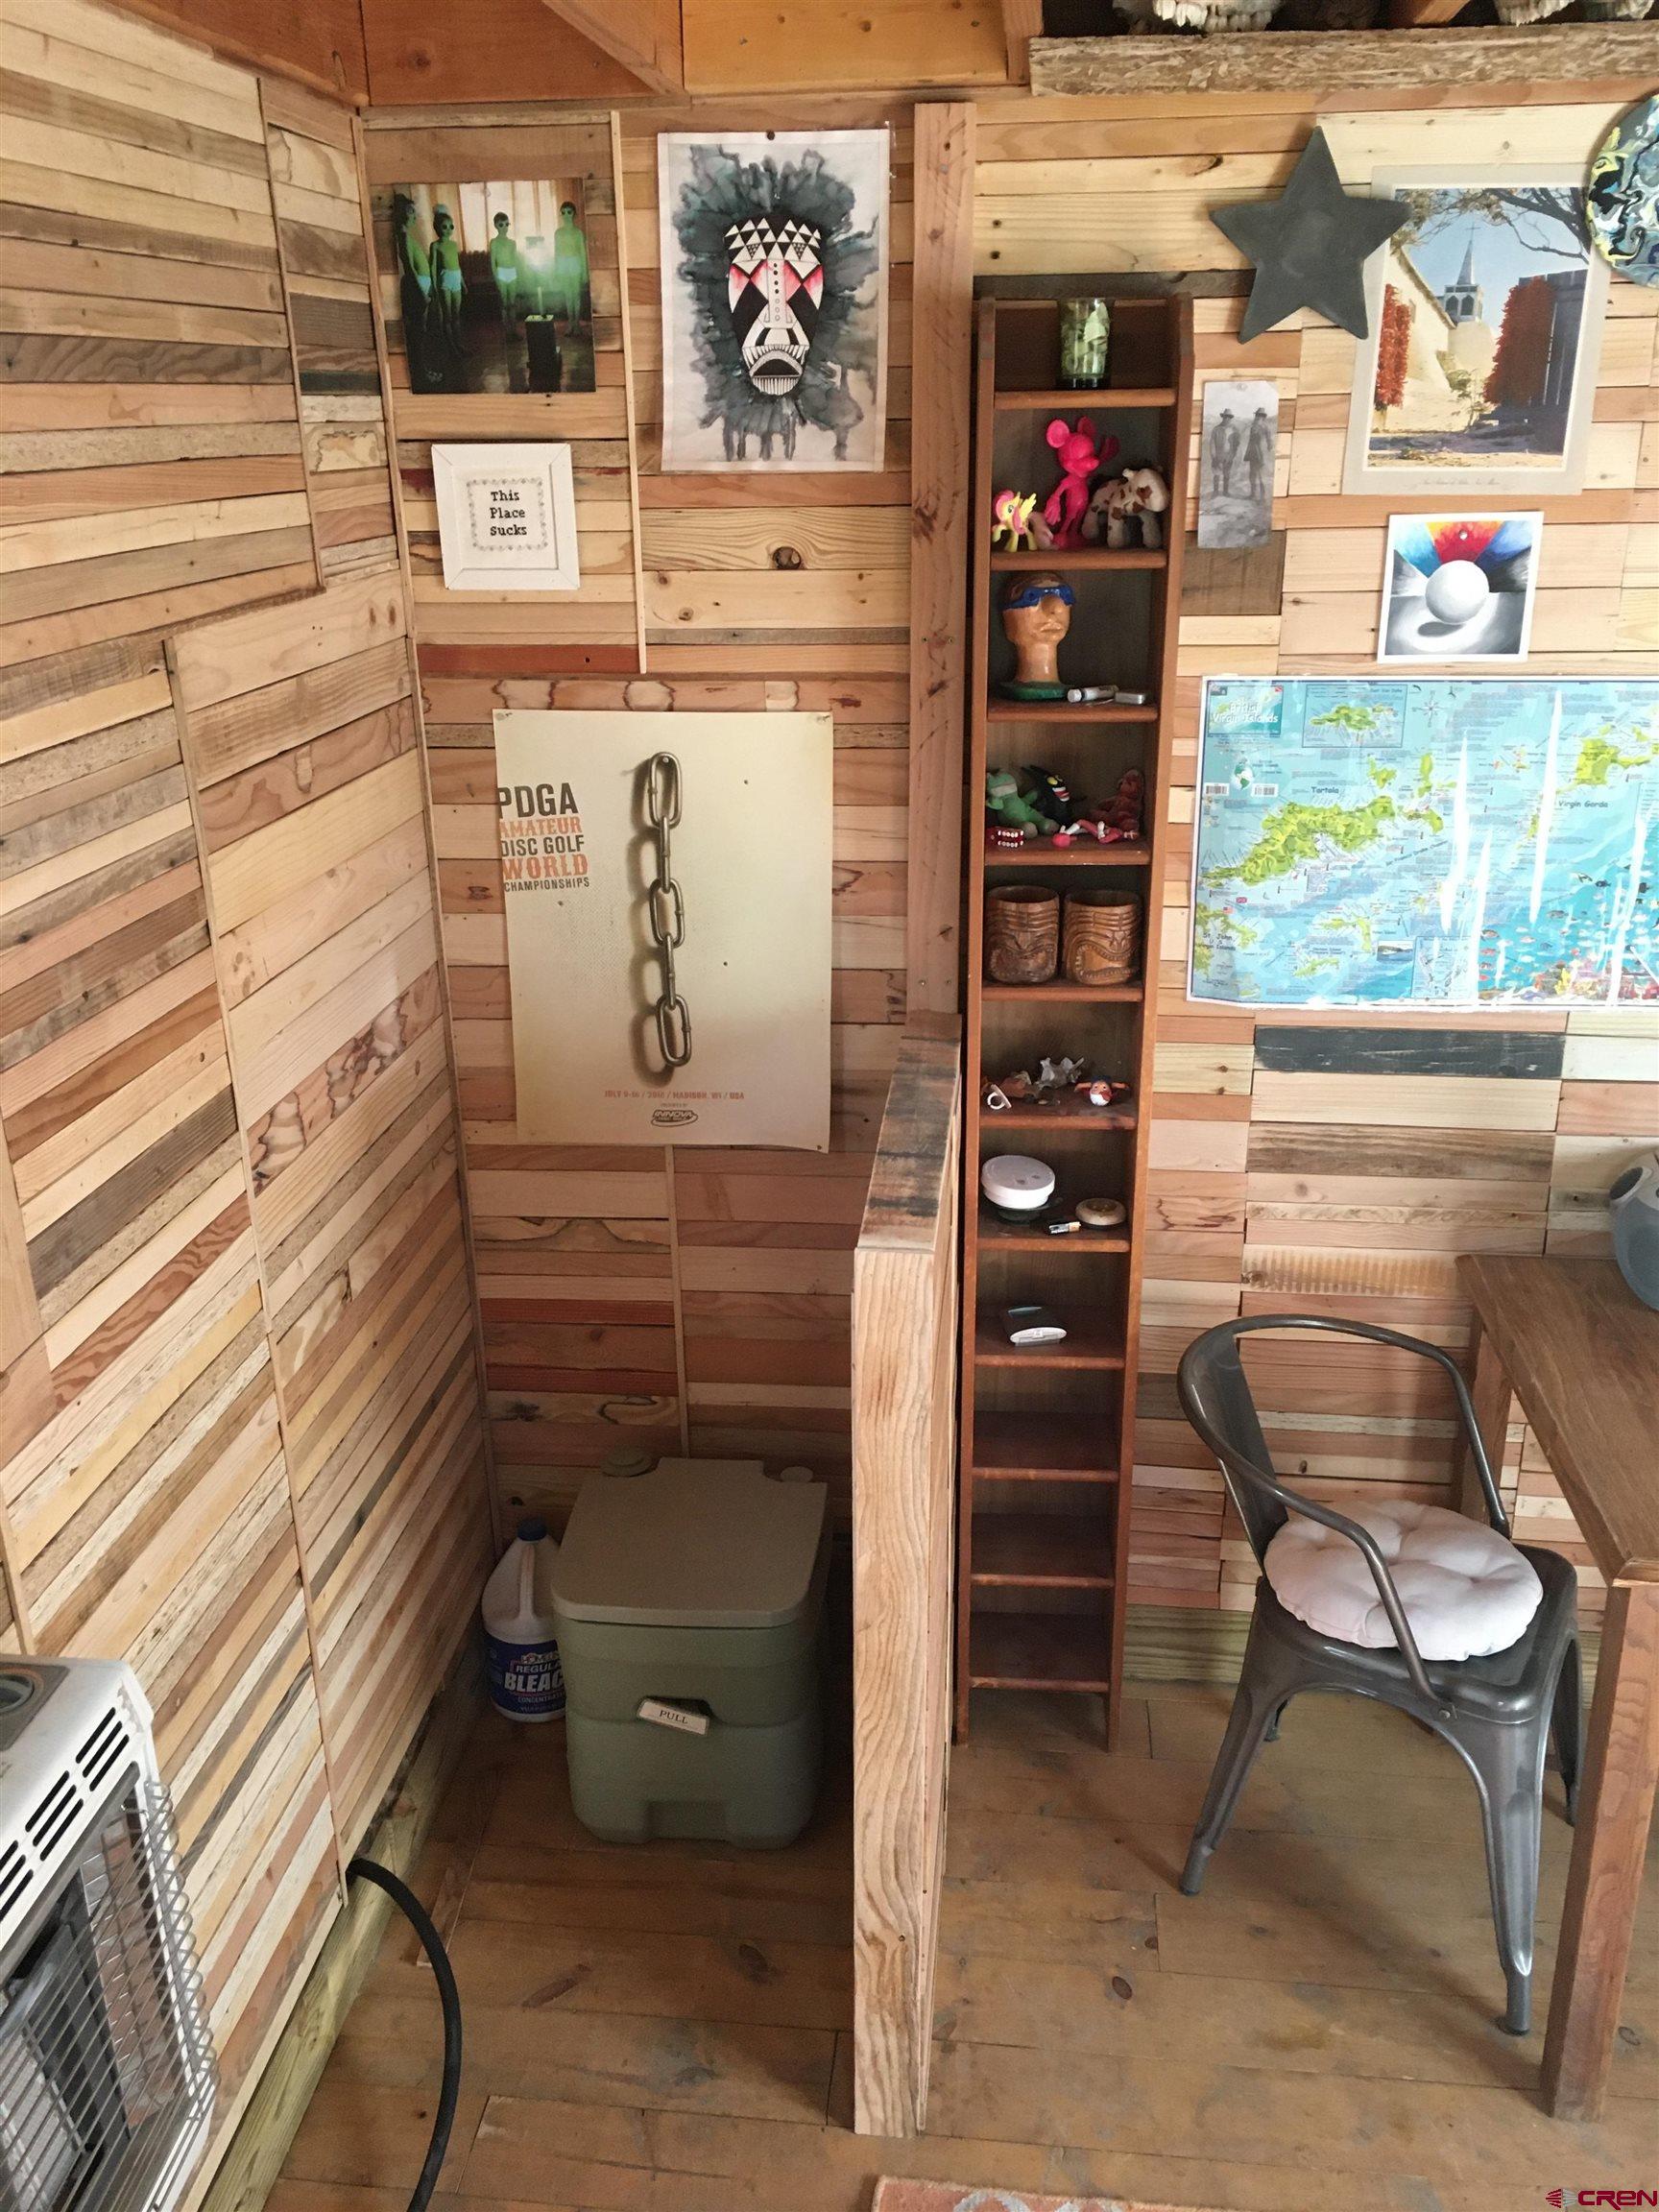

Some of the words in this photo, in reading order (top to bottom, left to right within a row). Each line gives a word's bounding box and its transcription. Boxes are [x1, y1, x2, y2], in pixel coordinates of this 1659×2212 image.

[490, 490, 519, 501] This
[490, 507, 526, 519] Place
[1243, 711, 1278, 723] Islads
[497, 782, 579, 819] PDGA
[1558, 800, 1581, 809] Virgin
[499, 816, 583, 838] AMATEUR
[500, 837, 539, 857] DISC
[543, 834, 585, 854] GOLF
[502, 854, 589, 880] WORLD
[504, 877, 590, 892] CHAMPIONSHIPS
[660, 1710, 688, 1724] PULL
